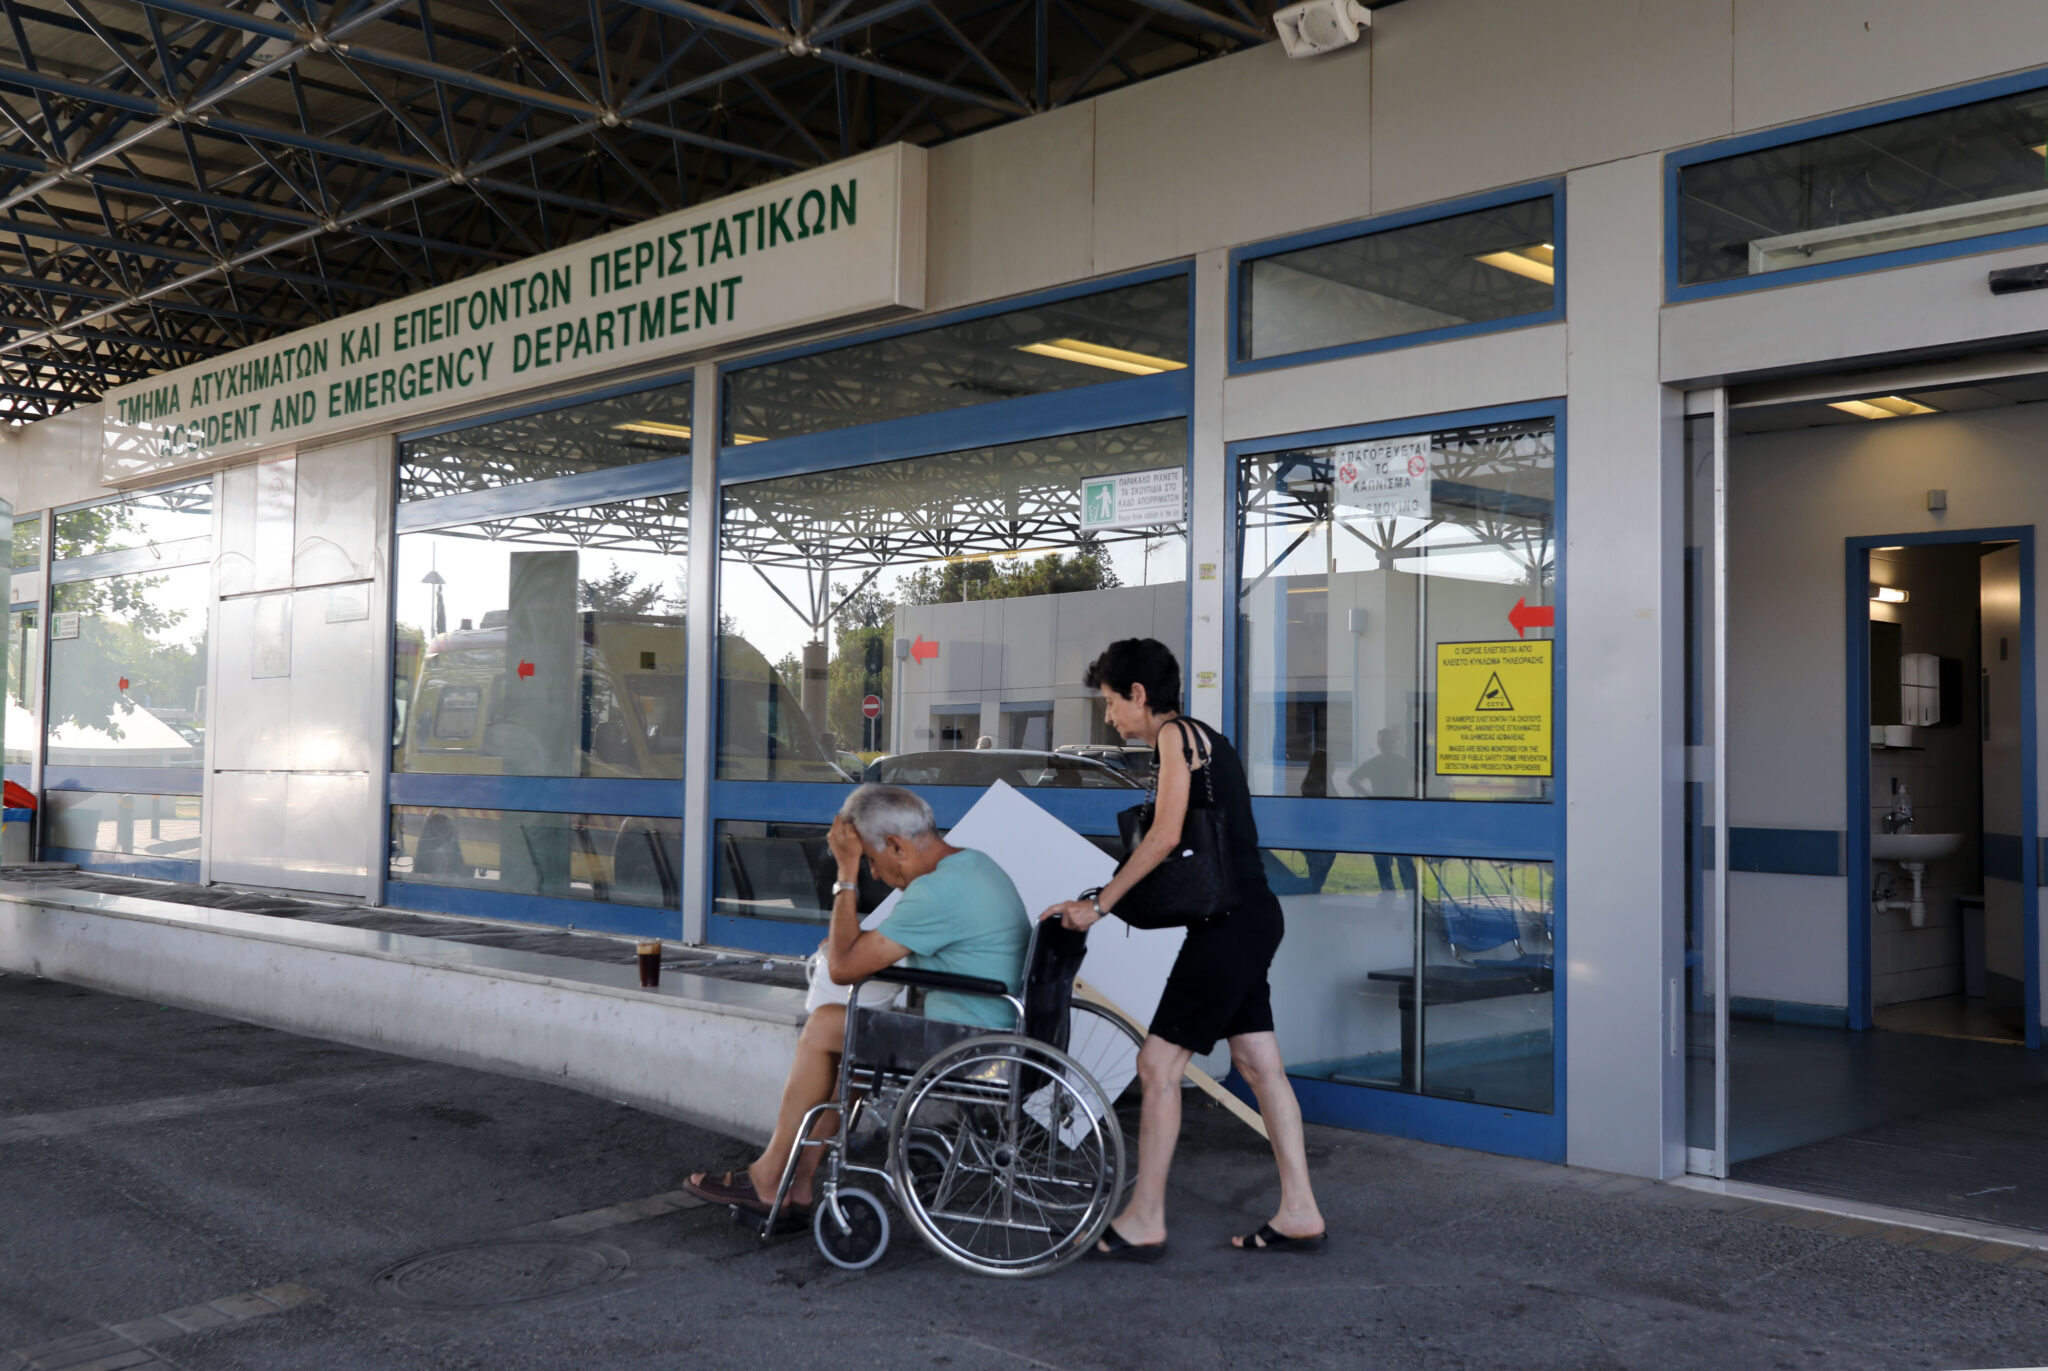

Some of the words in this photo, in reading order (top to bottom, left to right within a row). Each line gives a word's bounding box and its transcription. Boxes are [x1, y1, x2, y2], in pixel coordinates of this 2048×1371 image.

[117, 383, 180, 426] ΤΜΗΜΑ
[190, 338, 328, 409] ΑΤΥΧΗΜΑΤΩΝ
[340, 322, 380, 367] ΚΑΙ
[393, 264, 571, 352] ΕΠΕΙΓΟΝΤΩΝ
[590, 178, 858, 297] ΠΕΡΙΣΤΑΤΙΚΩΝ
[160, 403, 262, 459] ACCIDENT
[271, 389, 317, 432] AND
[329, 341, 494, 418] EMERGENCY
[513, 275, 743, 373] DEPARTMENT
[1340, 443, 1425, 462] ΑΠΑΓΟΡΕΥΕΤΑΙ
[1376, 463, 1388, 474] ΤΟ
[1353, 477, 1410, 492] ΚΑΠΝΙΣΜΑ
